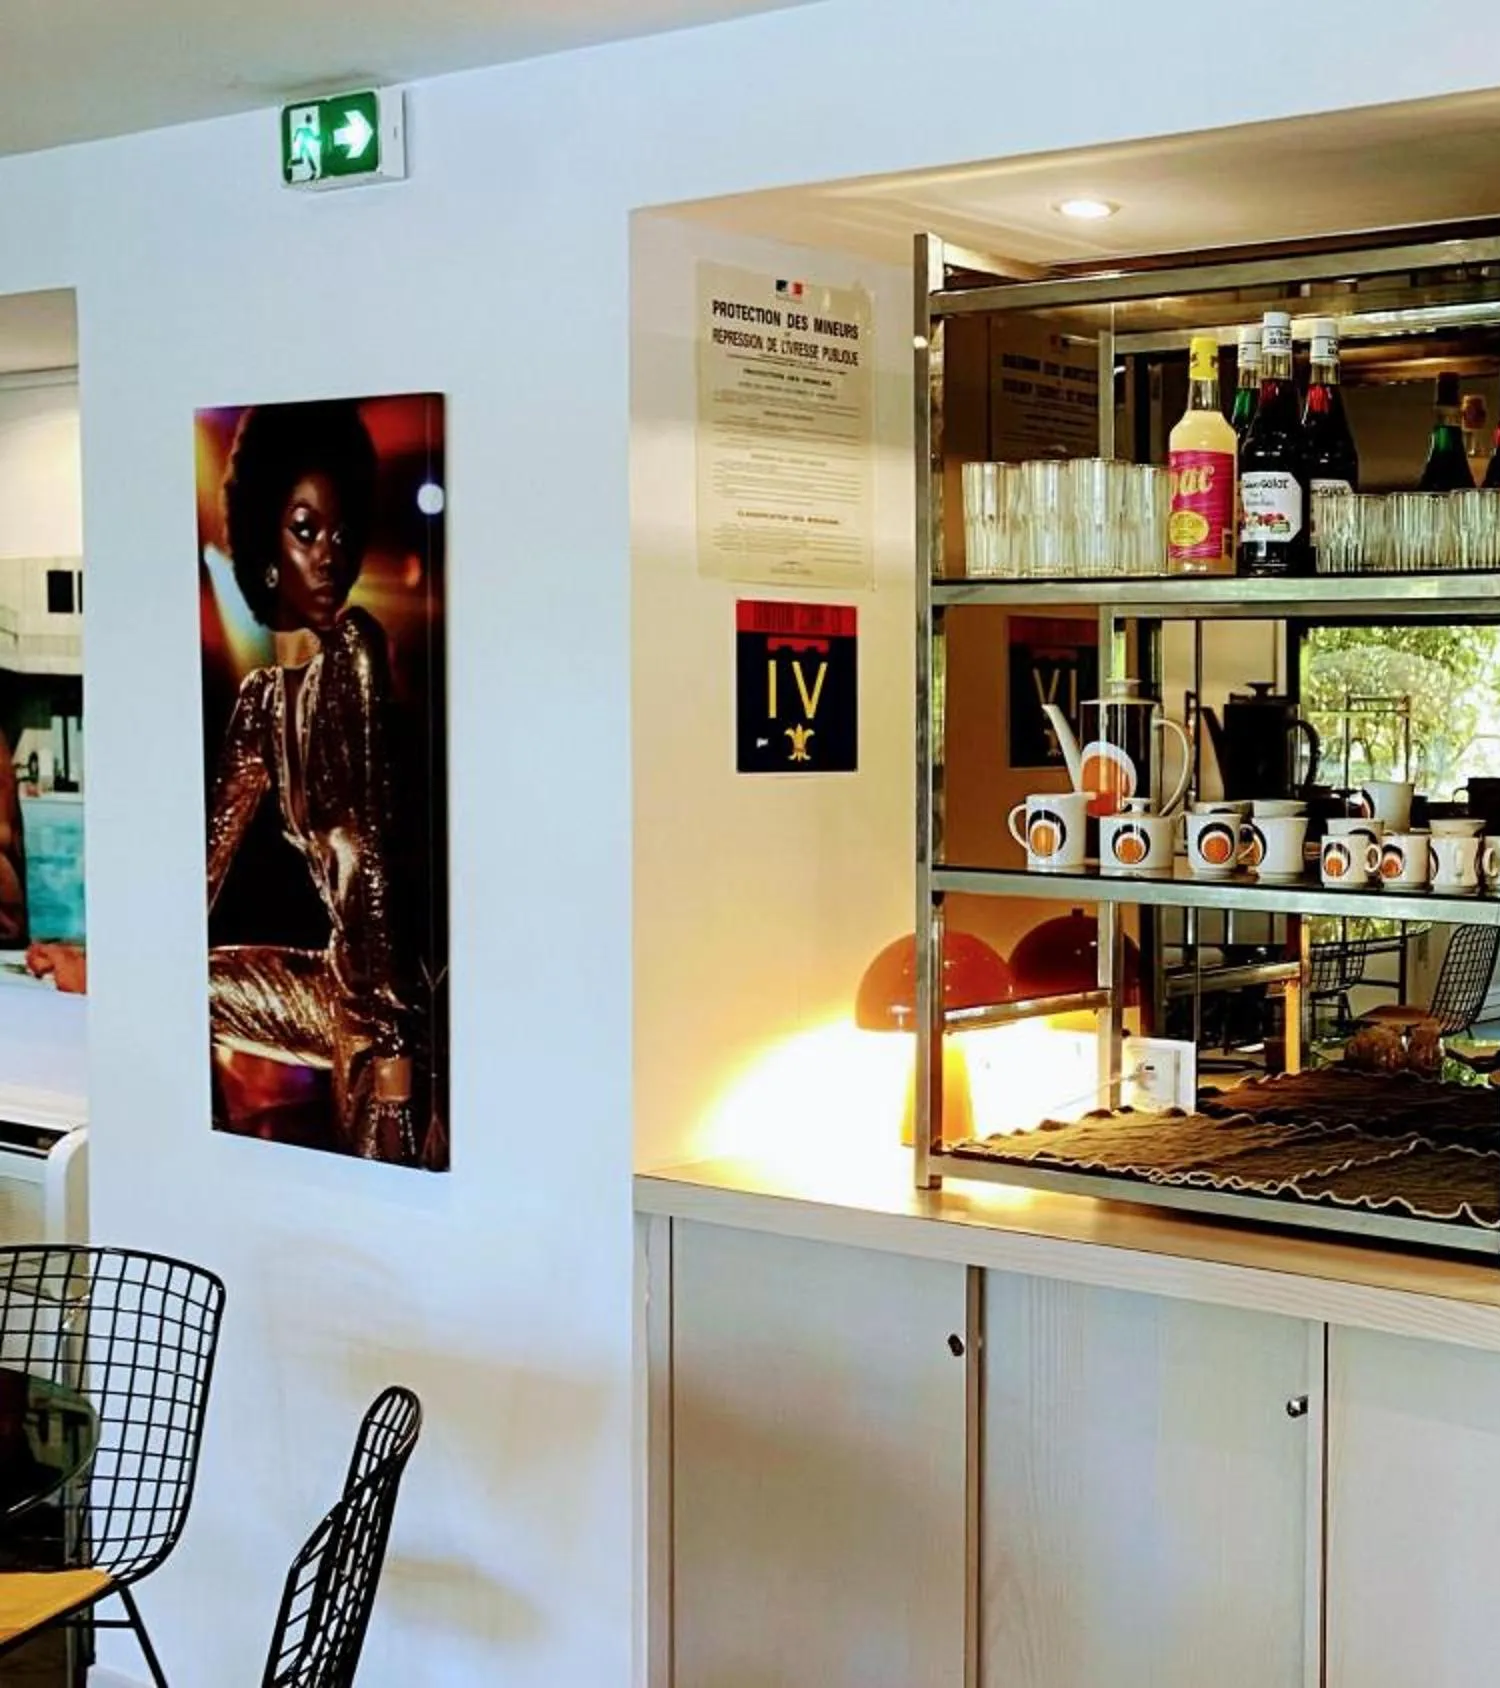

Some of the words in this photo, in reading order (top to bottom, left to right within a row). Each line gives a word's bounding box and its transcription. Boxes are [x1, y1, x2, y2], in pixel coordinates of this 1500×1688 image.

[712, 300, 780, 326] PROTECTION
[787, 314, 809, 331] DES
[814, 318, 859, 340] MINEURS
[767, 337, 777, 353] DE
[822, 347, 859, 367] PUBLIQUE
[768, 660, 828, 719] IV
